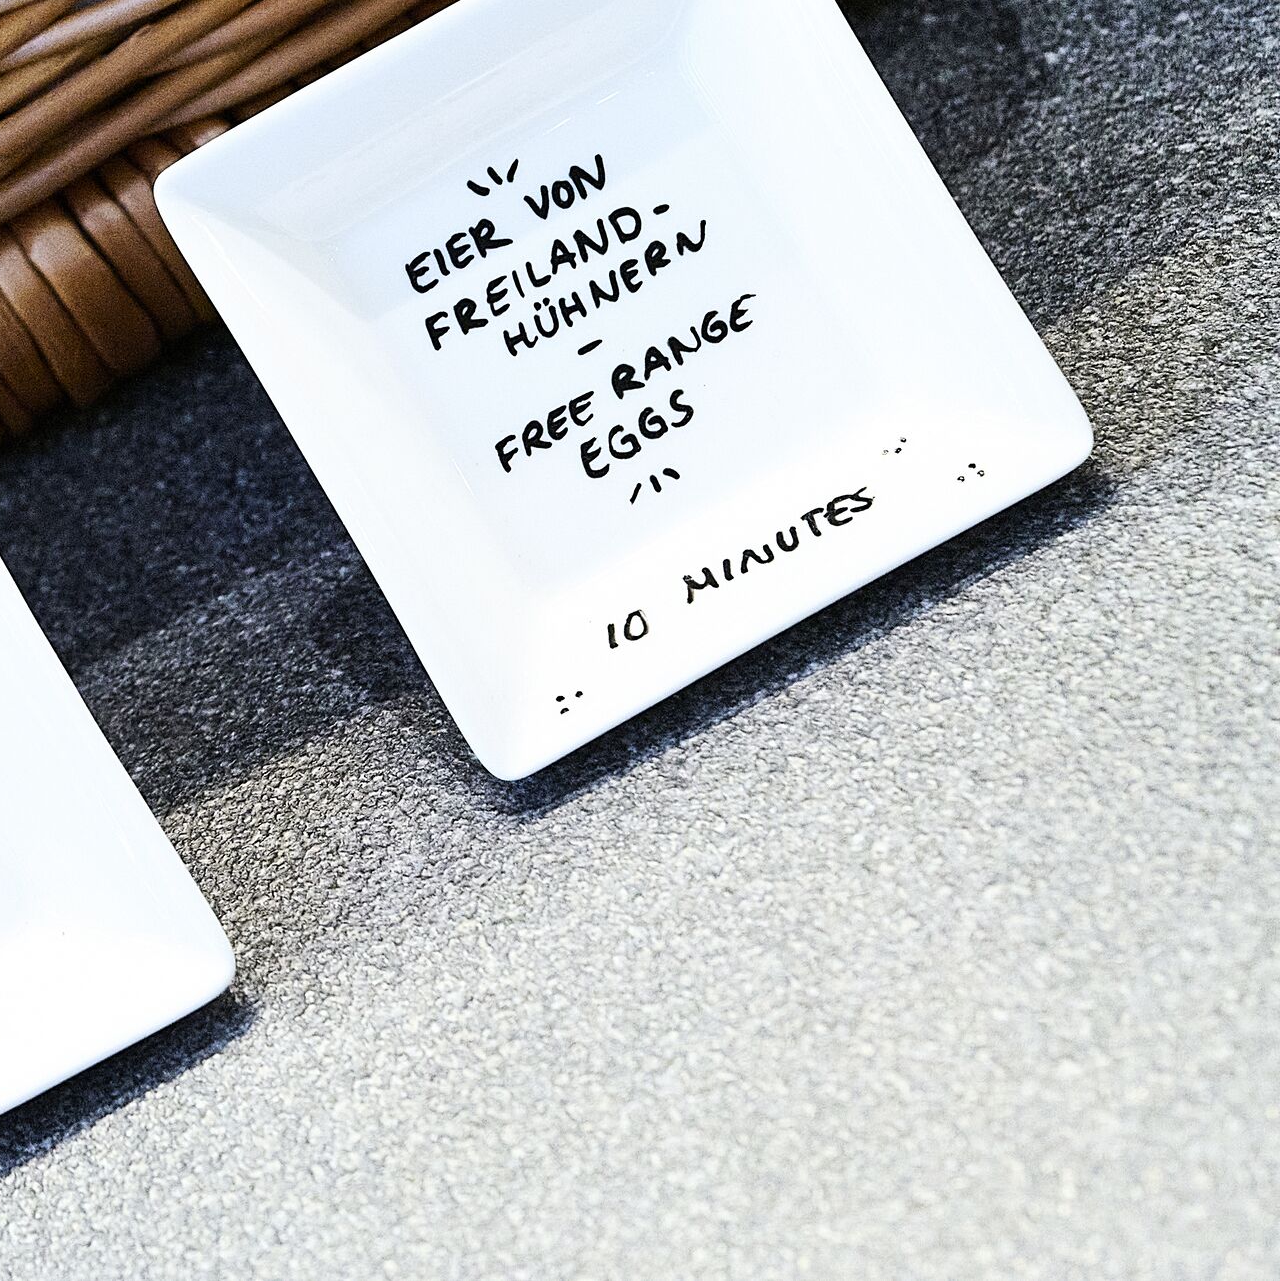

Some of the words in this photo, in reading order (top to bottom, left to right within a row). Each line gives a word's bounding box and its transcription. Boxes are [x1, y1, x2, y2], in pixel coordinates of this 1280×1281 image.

[404, 218, 514, 294] EIER
[523, 153, 606, 221] VON
[424, 203, 670, 352] FREILAND-
[502, 219, 707, 357] HÜHNERN
[494, 390, 595, 474] FREE
[611, 293, 757, 400] RANGE
[580, 389, 695, 479] EGGS
[607, 609, 651, 650] 10
[681, 486, 876, 605] MINUTES
